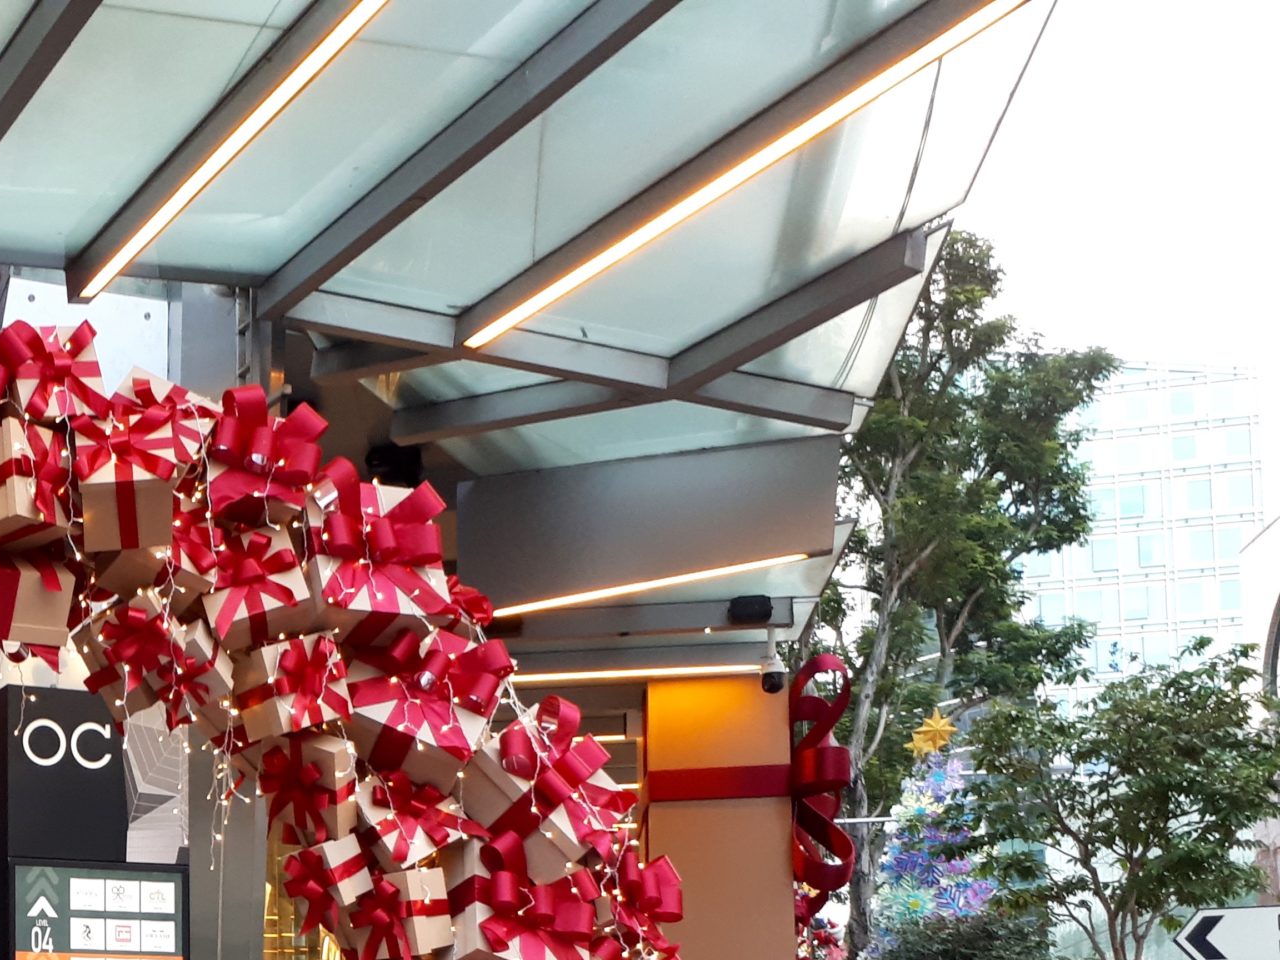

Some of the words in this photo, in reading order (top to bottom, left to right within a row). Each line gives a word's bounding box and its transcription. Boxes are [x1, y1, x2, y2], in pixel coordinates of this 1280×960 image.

[22, 718, 112, 769] OC
[35, 919, 49, 927] LEVEL
[31, 926, 54, 953] 04
